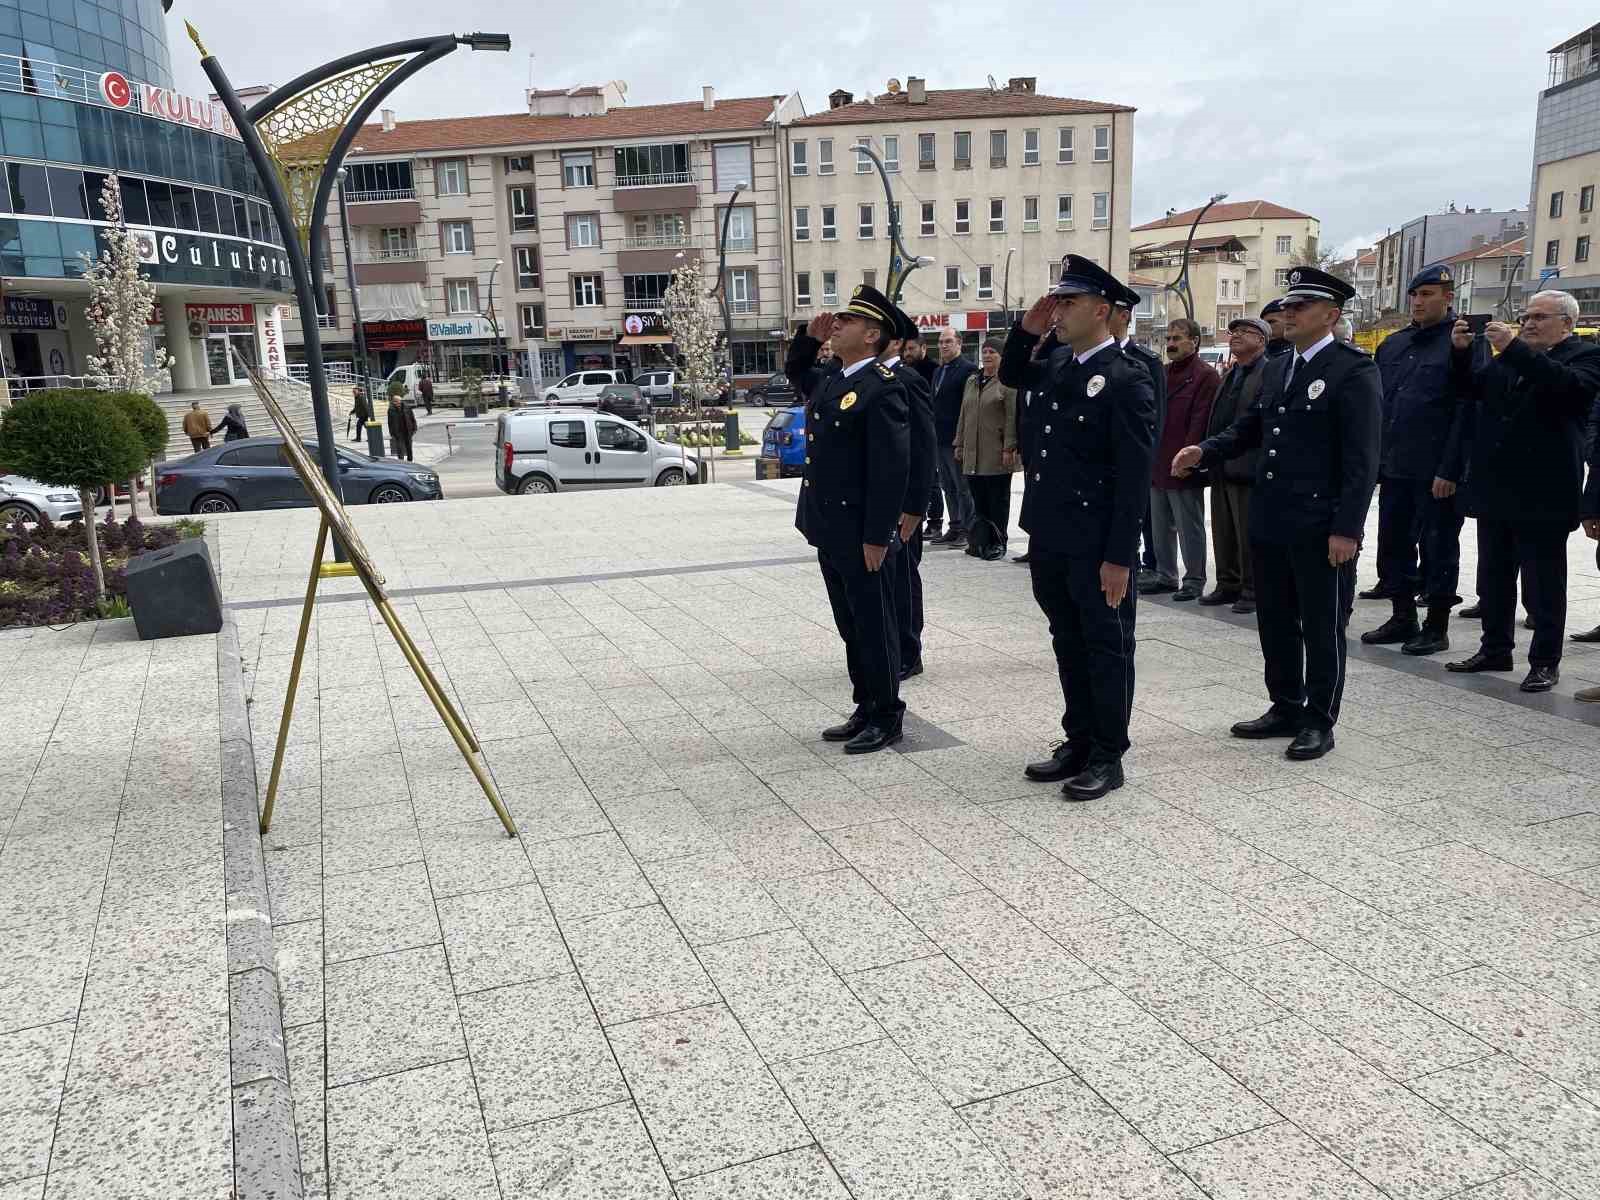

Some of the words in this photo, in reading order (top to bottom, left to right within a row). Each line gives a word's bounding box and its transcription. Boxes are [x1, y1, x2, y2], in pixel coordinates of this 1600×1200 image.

[143, 84, 213, 129] KULU
[188, 305, 244, 324] CZANESİ
[911, 313, 950, 327] ZANE
[438, 321, 473, 336] Vaillant
[264, 320, 281, 370] ECZANE
